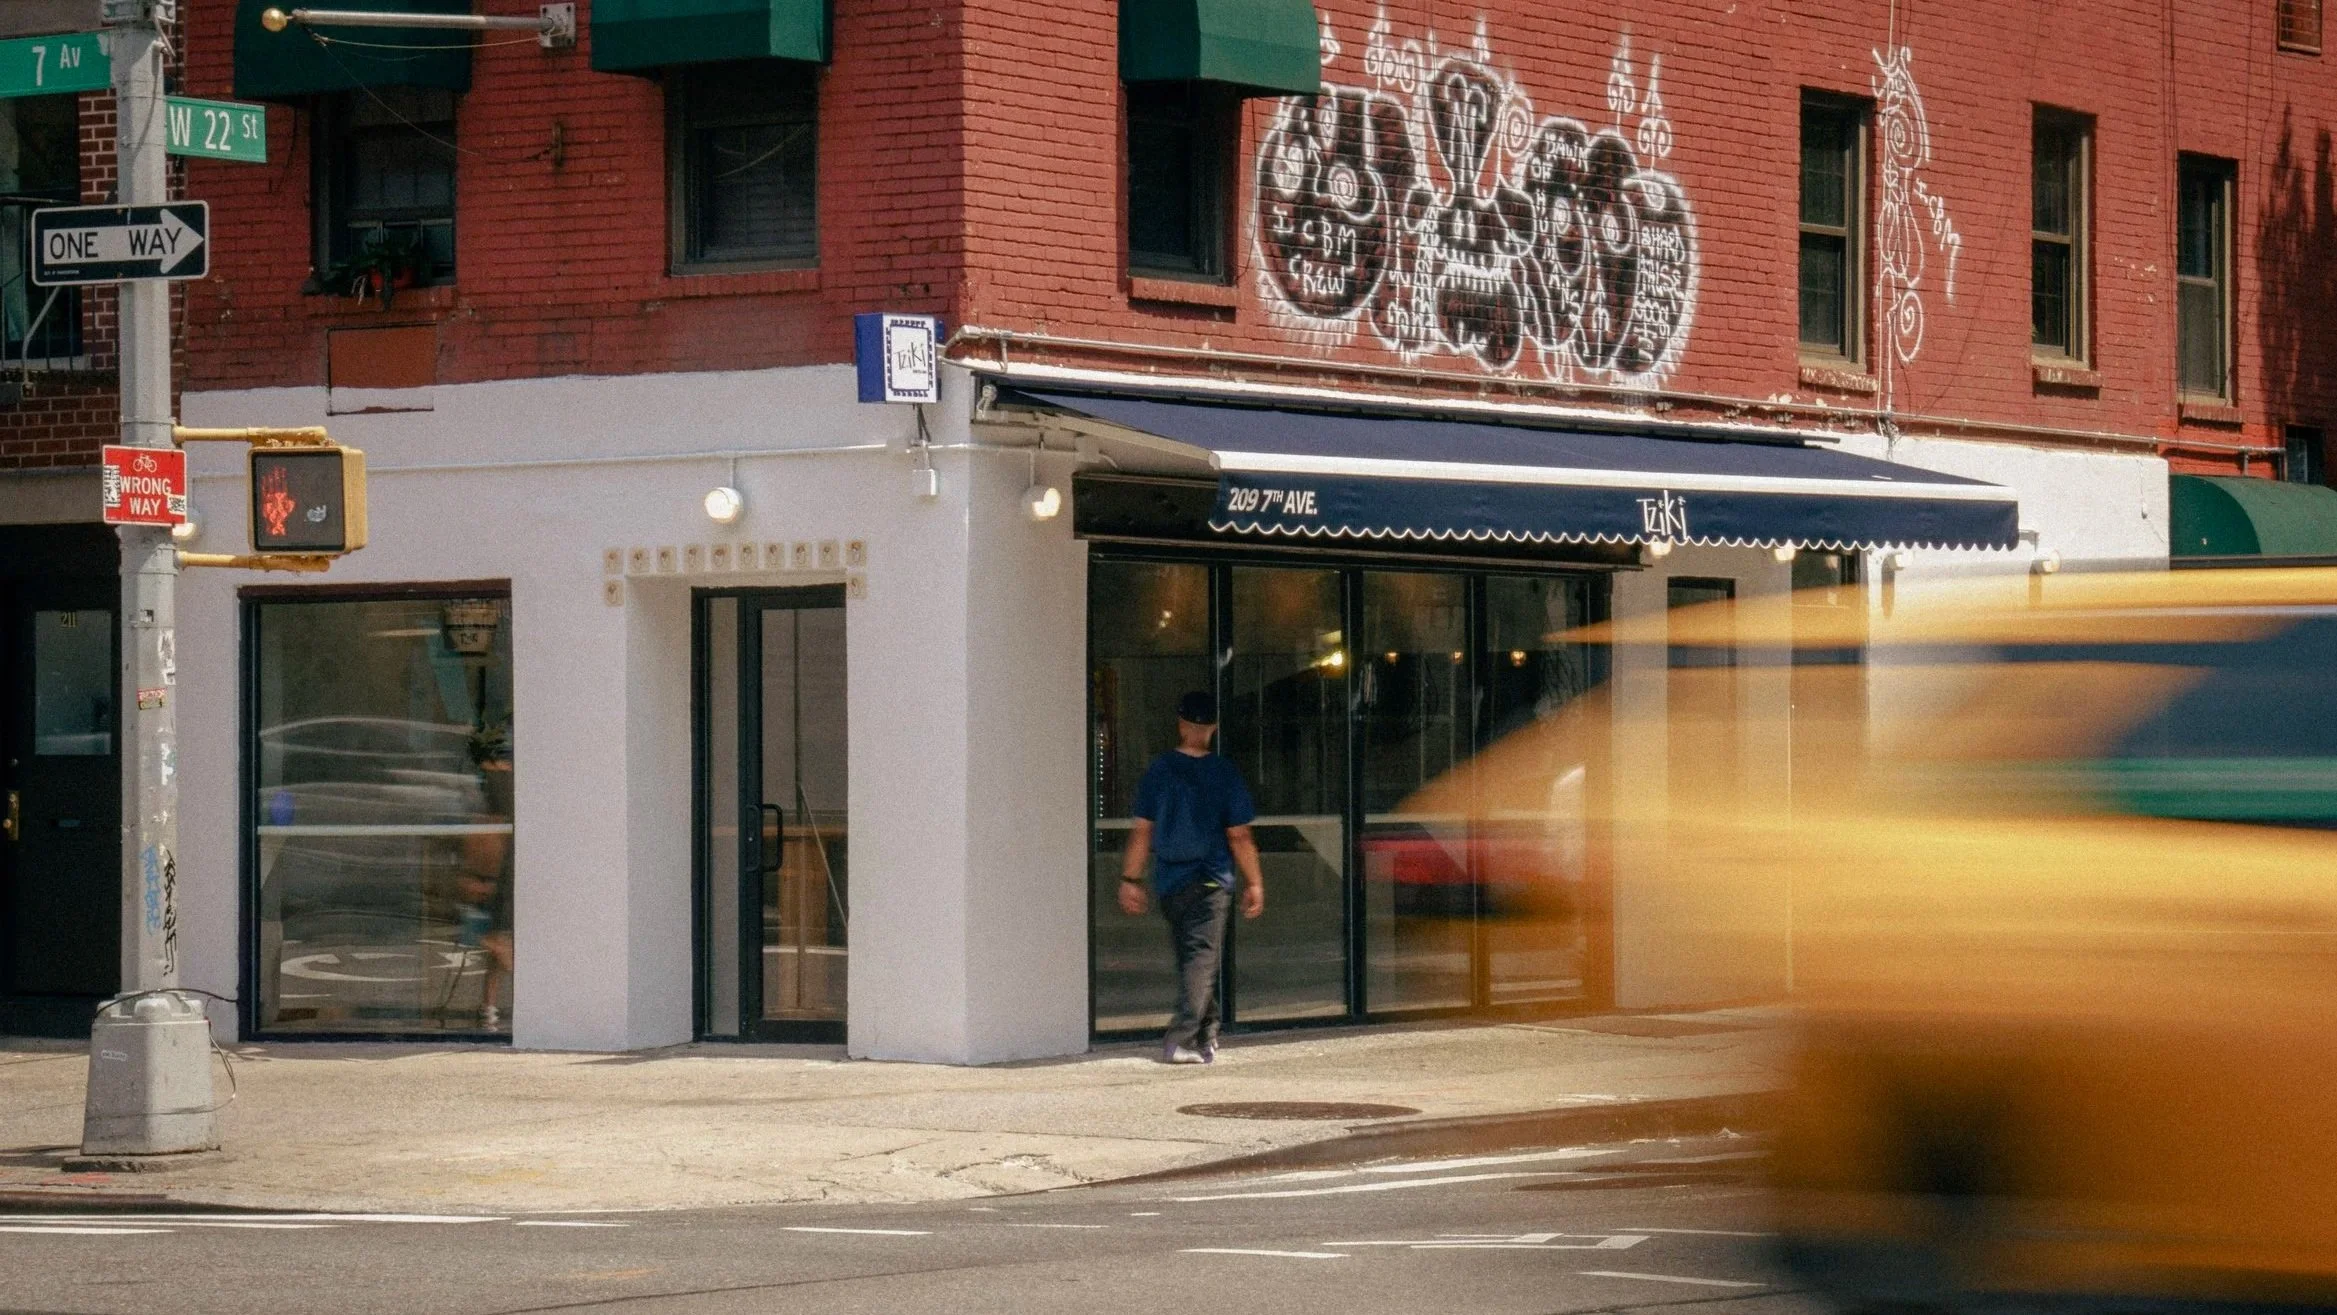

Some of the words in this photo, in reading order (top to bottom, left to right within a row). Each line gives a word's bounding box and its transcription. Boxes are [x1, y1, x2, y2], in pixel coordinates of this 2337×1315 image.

[32, 45, 47, 87] 7
[169, 105, 192, 147] W
[204, 109, 232, 151] 22
[242, 113, 259, 139] St
[50, 231, 99, 260] ONE
[128, 227, 182, 256] WAY
[120, 475, 172, 496] WRONG
[129, 497, 162, 516] WAY
[1227, 487, 1259, 512] 209
[1282, 489, 1318, 515] AVE.
[60, 610, 77, 628] 211
